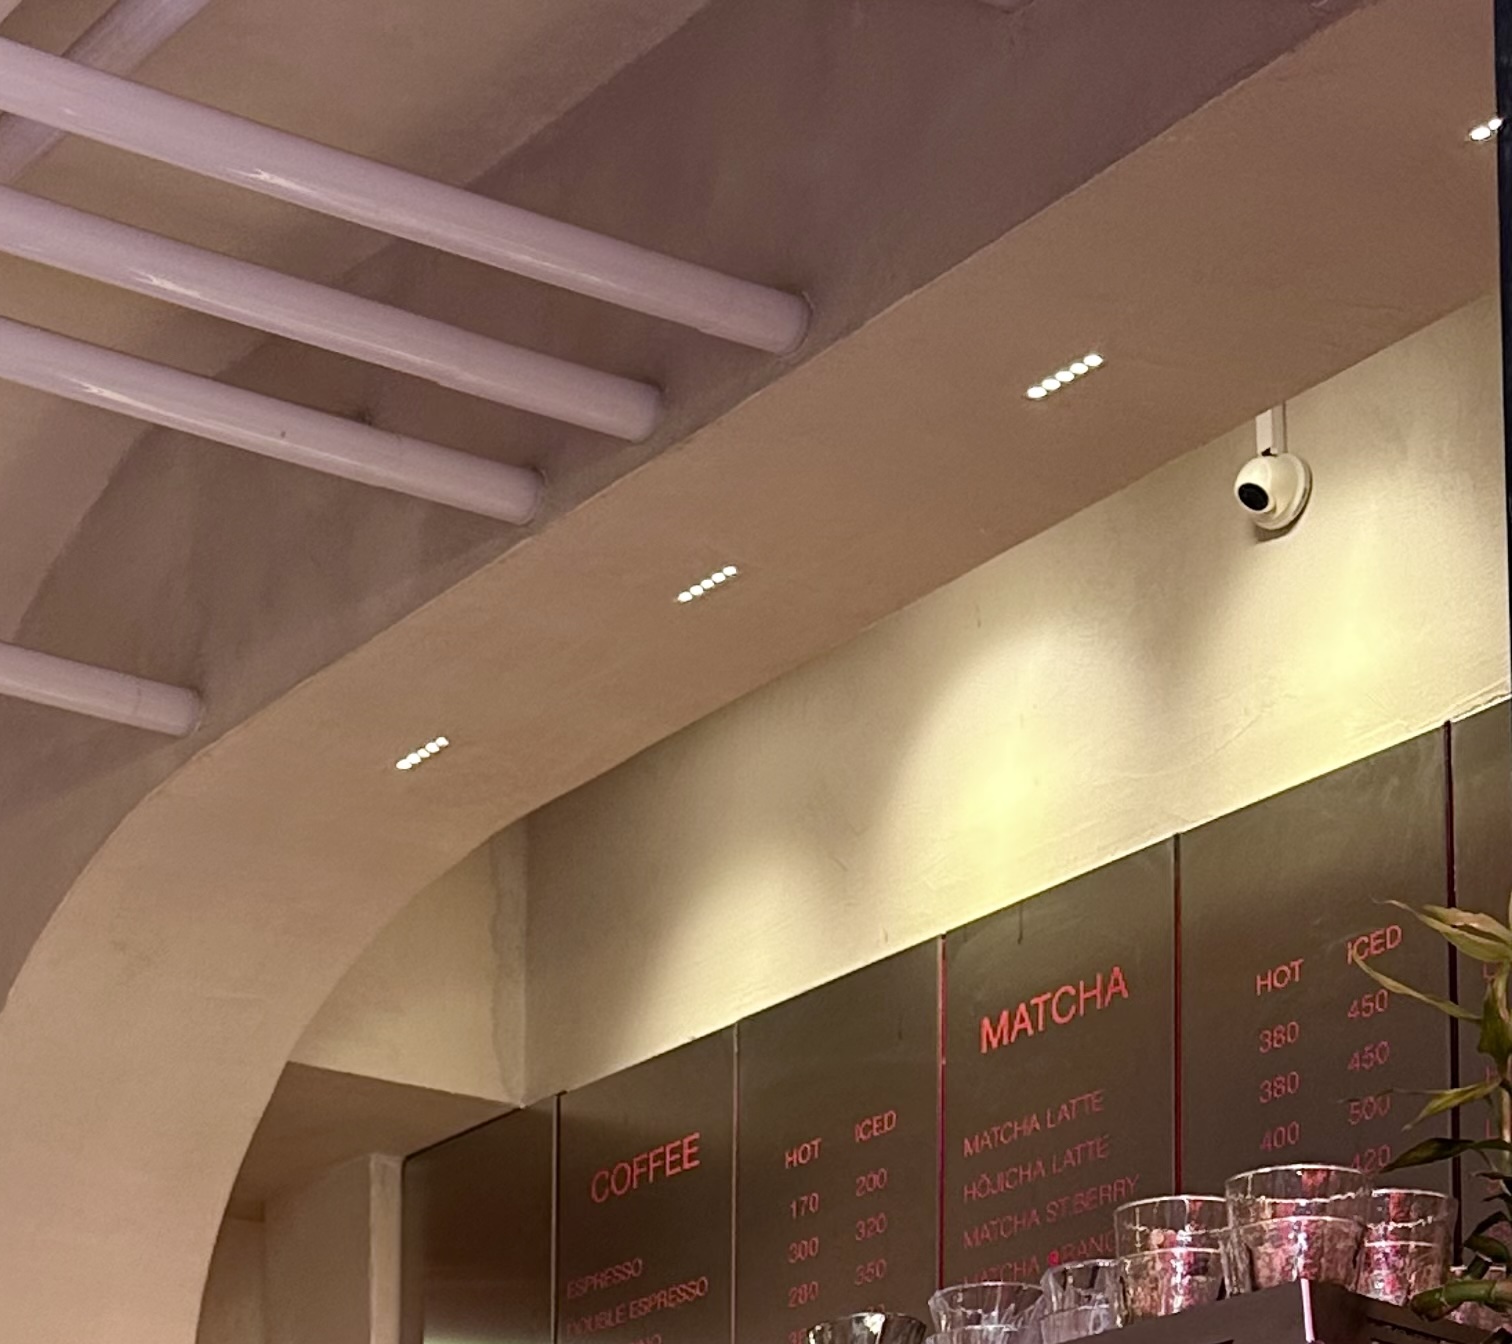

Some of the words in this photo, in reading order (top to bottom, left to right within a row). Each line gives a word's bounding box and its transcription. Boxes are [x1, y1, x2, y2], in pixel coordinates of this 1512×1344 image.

[1255, 959, 1304, 996] HOT
[1346, 925, 1402, 964] ICED
[979, 966, 1129, 1054] MATCHA
[1259, 1021, 1300, 1053] 380
[1347, 989, 1388, 1019] 450
[1259, 1071, 1300, 1103] 380
[1347, 1040, 1389, 1072] 450
[785, 1138, 822, 1169] HOT
[854, 1110, 897, 1143] ICED
[963, 1113, 1040, 1158] MATCHA
[1046, 1089, 1105, 1130] LATTE
[1260, 1121, 1300, 1151] 400
[1348, 1094, 1391, 1126] 500
[590, 1132, 701, 1203] COFFEE
[1051, 1133, 1110, 1175] LATTE
[790, 1193, 819, 1219] 170
[855, 1168, 887, 1197] 200
[963, 1209, 1039, 1249] MATCHA
[567, 1258, 643, 1299] ESPRESSO
[567, 1303, 627, 1336] DOUBLE
[629, 1276, 709, 1320] ESPRESSO
